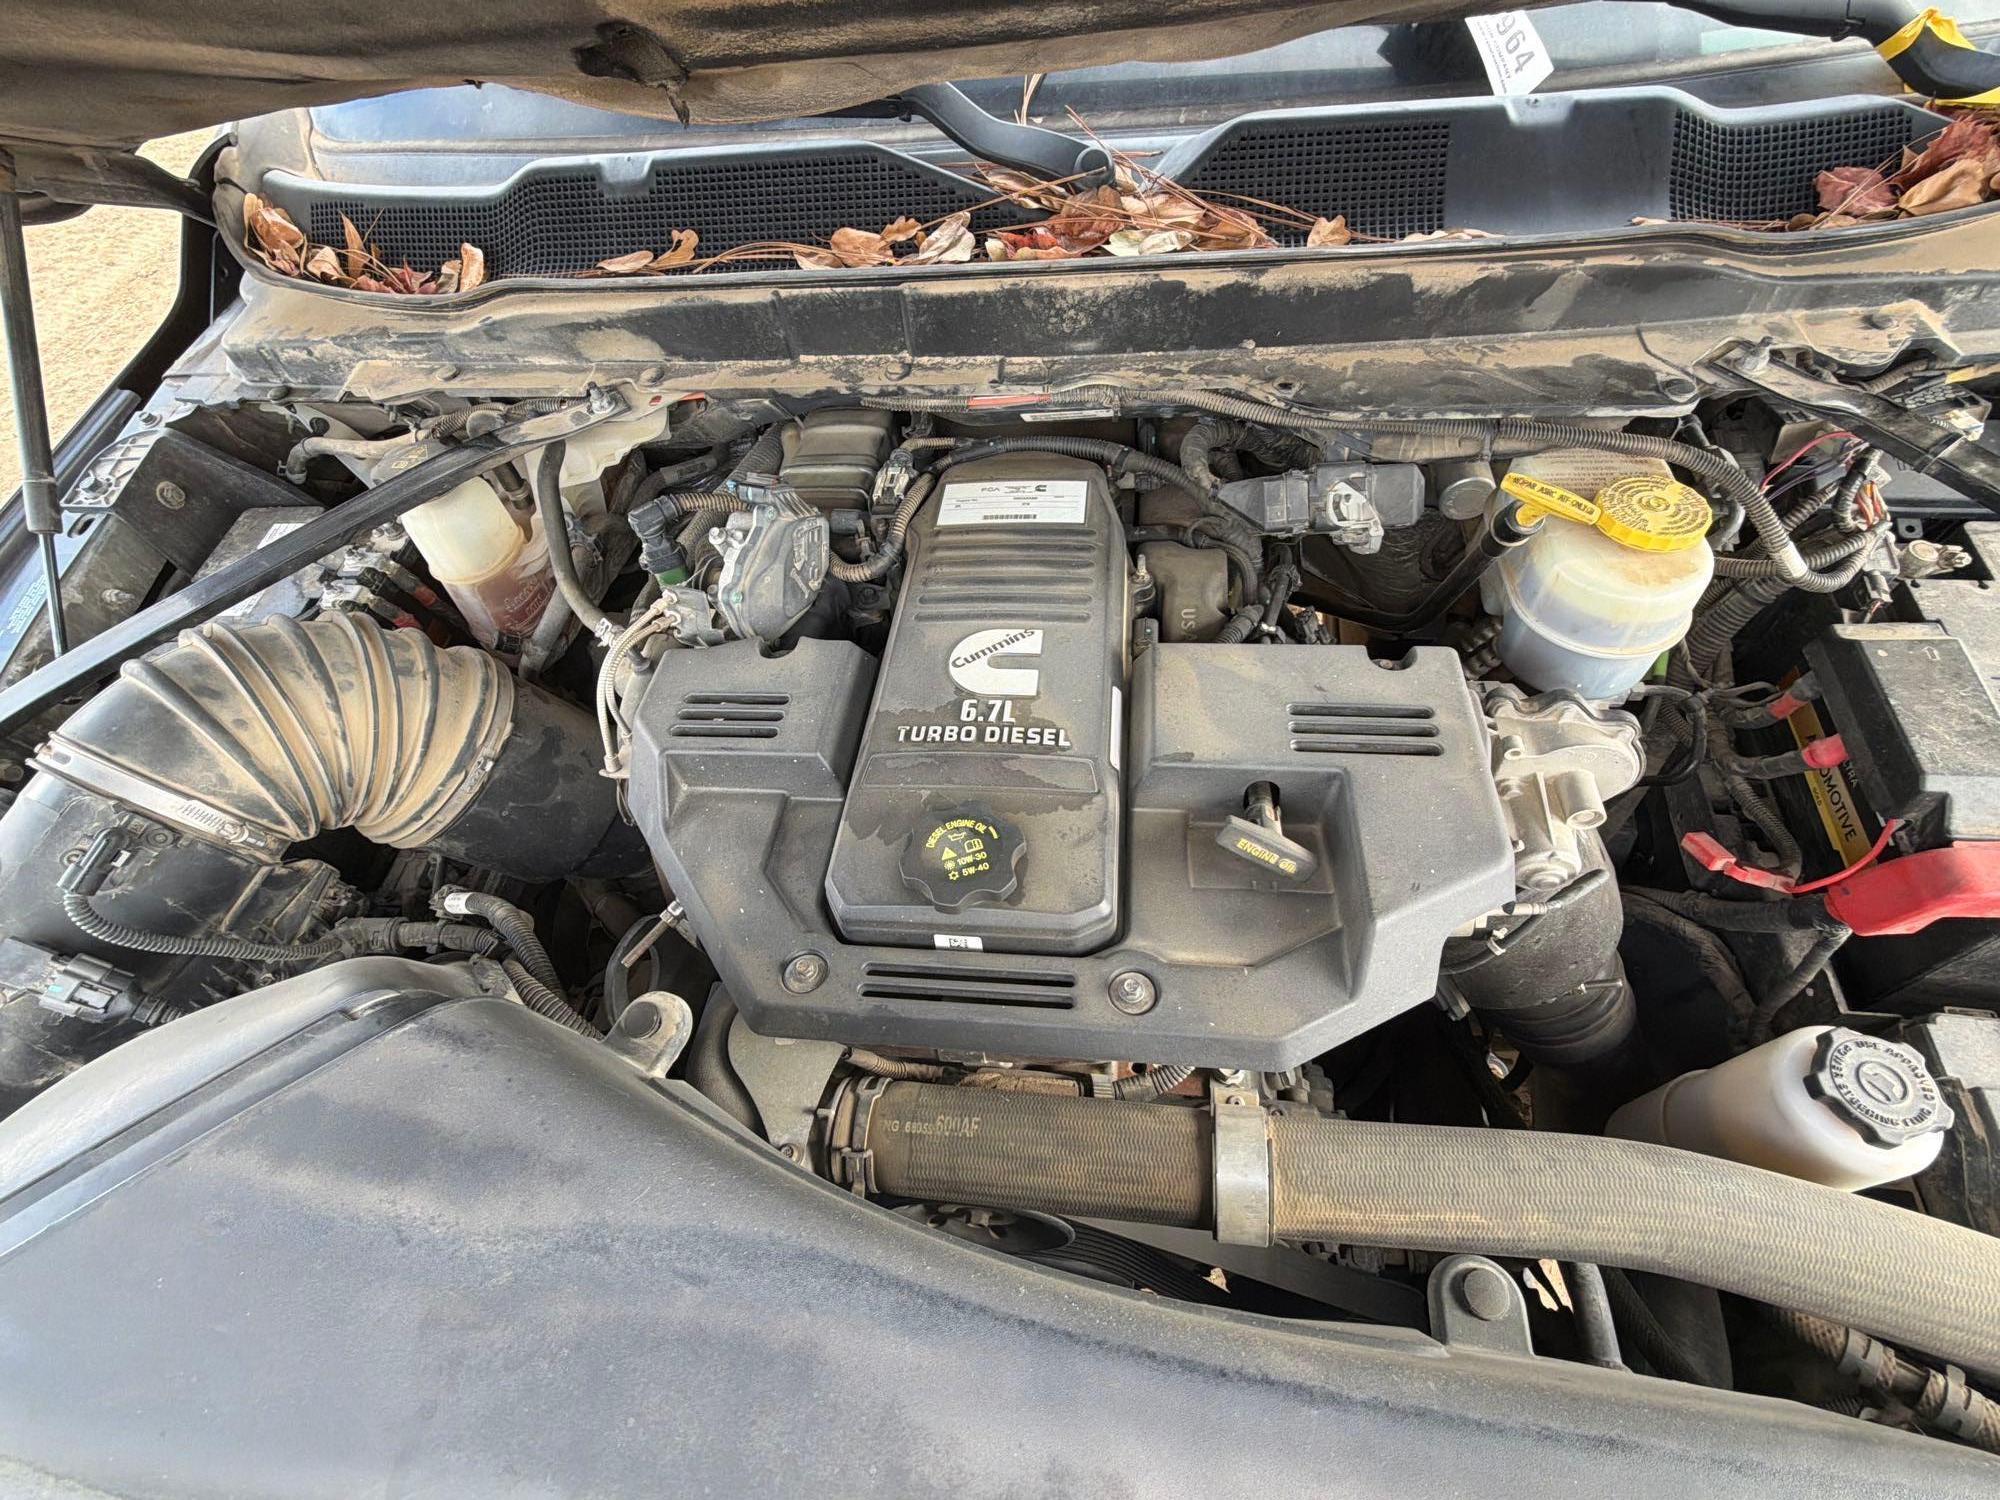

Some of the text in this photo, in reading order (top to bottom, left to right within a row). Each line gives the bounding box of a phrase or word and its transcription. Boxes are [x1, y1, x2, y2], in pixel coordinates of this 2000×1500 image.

[951, 629, 1036, 669] Cummins
[960, 699, 1016, 724] 6.7L
[897, 725, 1072, 747] TURBO DIESEL
[926, 819, 987, 848] DIESEL ENGINE OIL
[957, 851, 987, 866] 10W-30
[1236, 838, 1297, 874] ENGINE OIL
[962, 862, 990, 877] 5W-40
